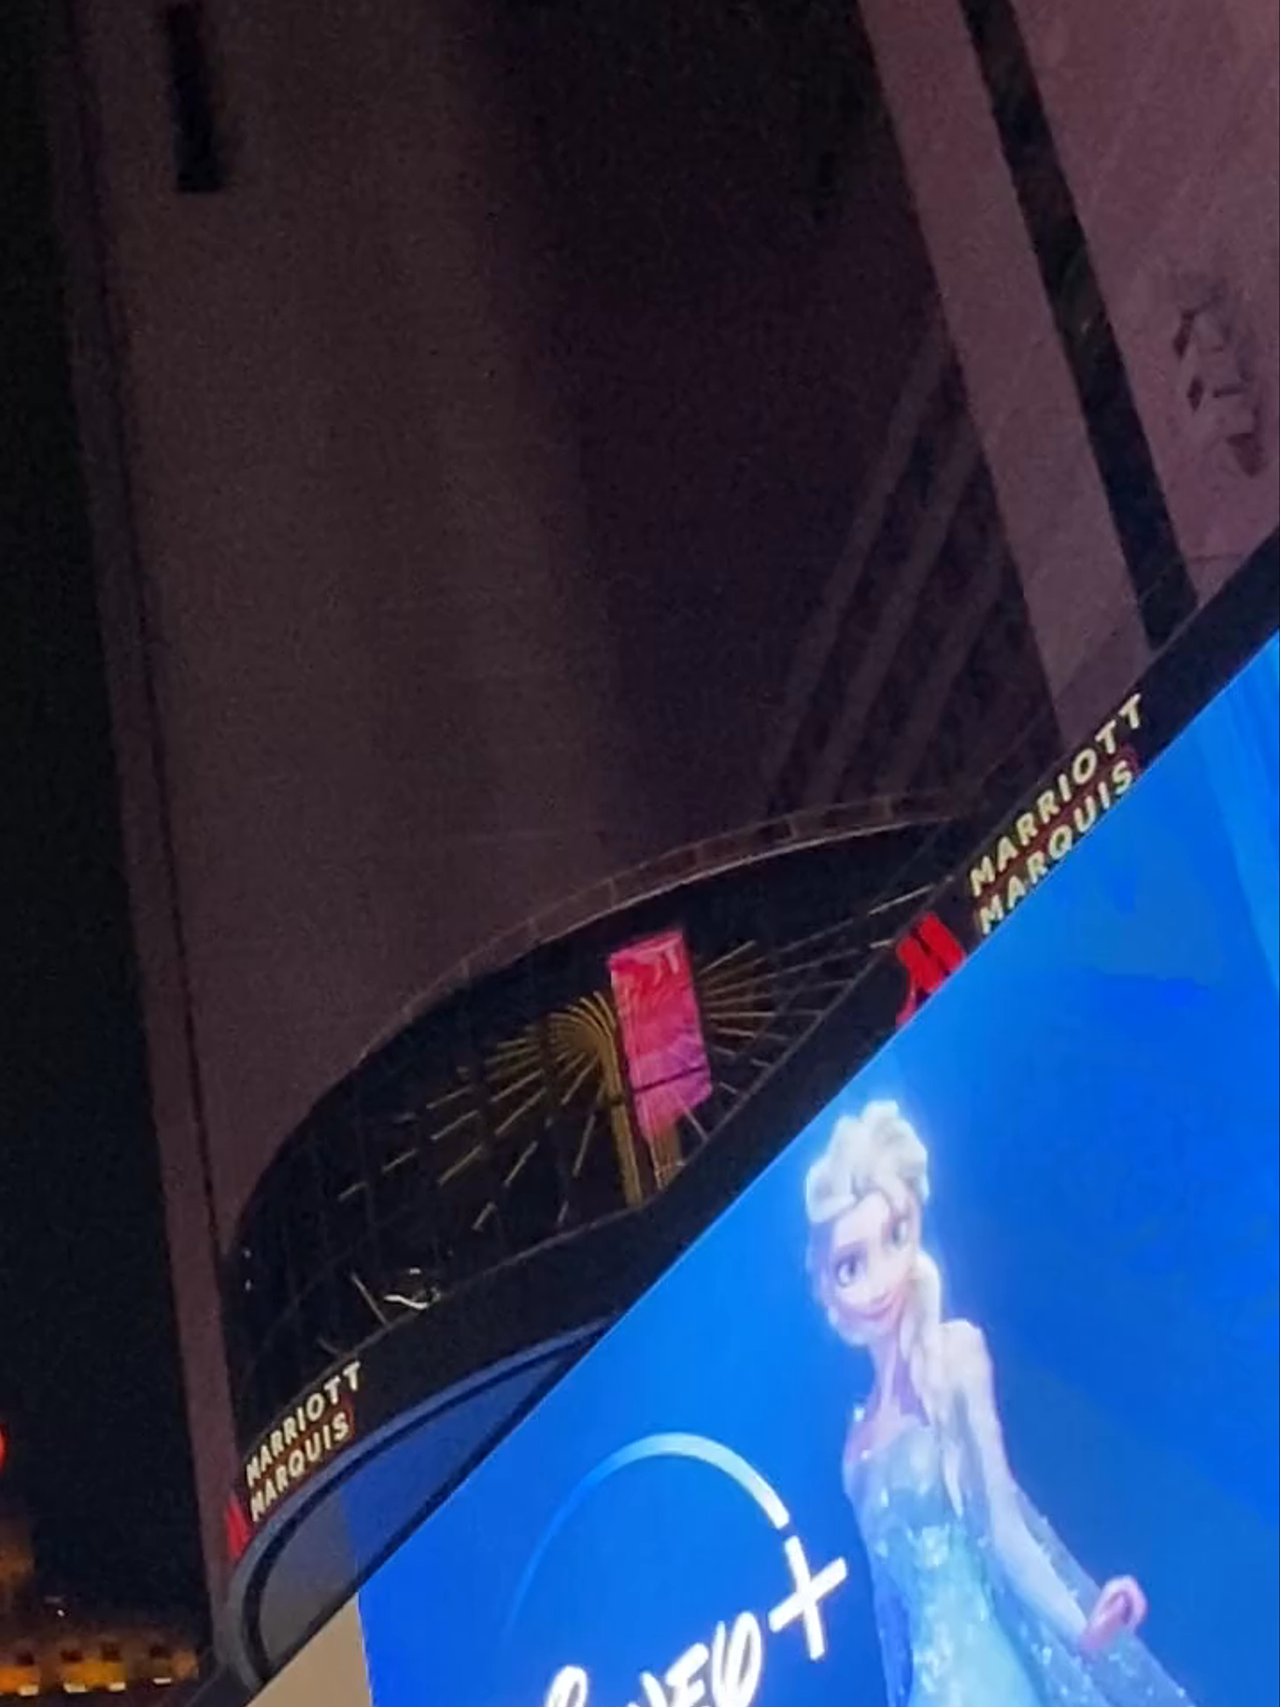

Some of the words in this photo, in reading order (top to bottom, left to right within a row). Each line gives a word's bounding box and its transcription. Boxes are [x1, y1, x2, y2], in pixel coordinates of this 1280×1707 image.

[970, 693, 1141, 897] MARRIOTT
[980, 761, 1132, 935] MARQUIS
[246, 1360, 361, 1489] MARRIOTT
[251, 1411, 350, 1523] MARQUIS
